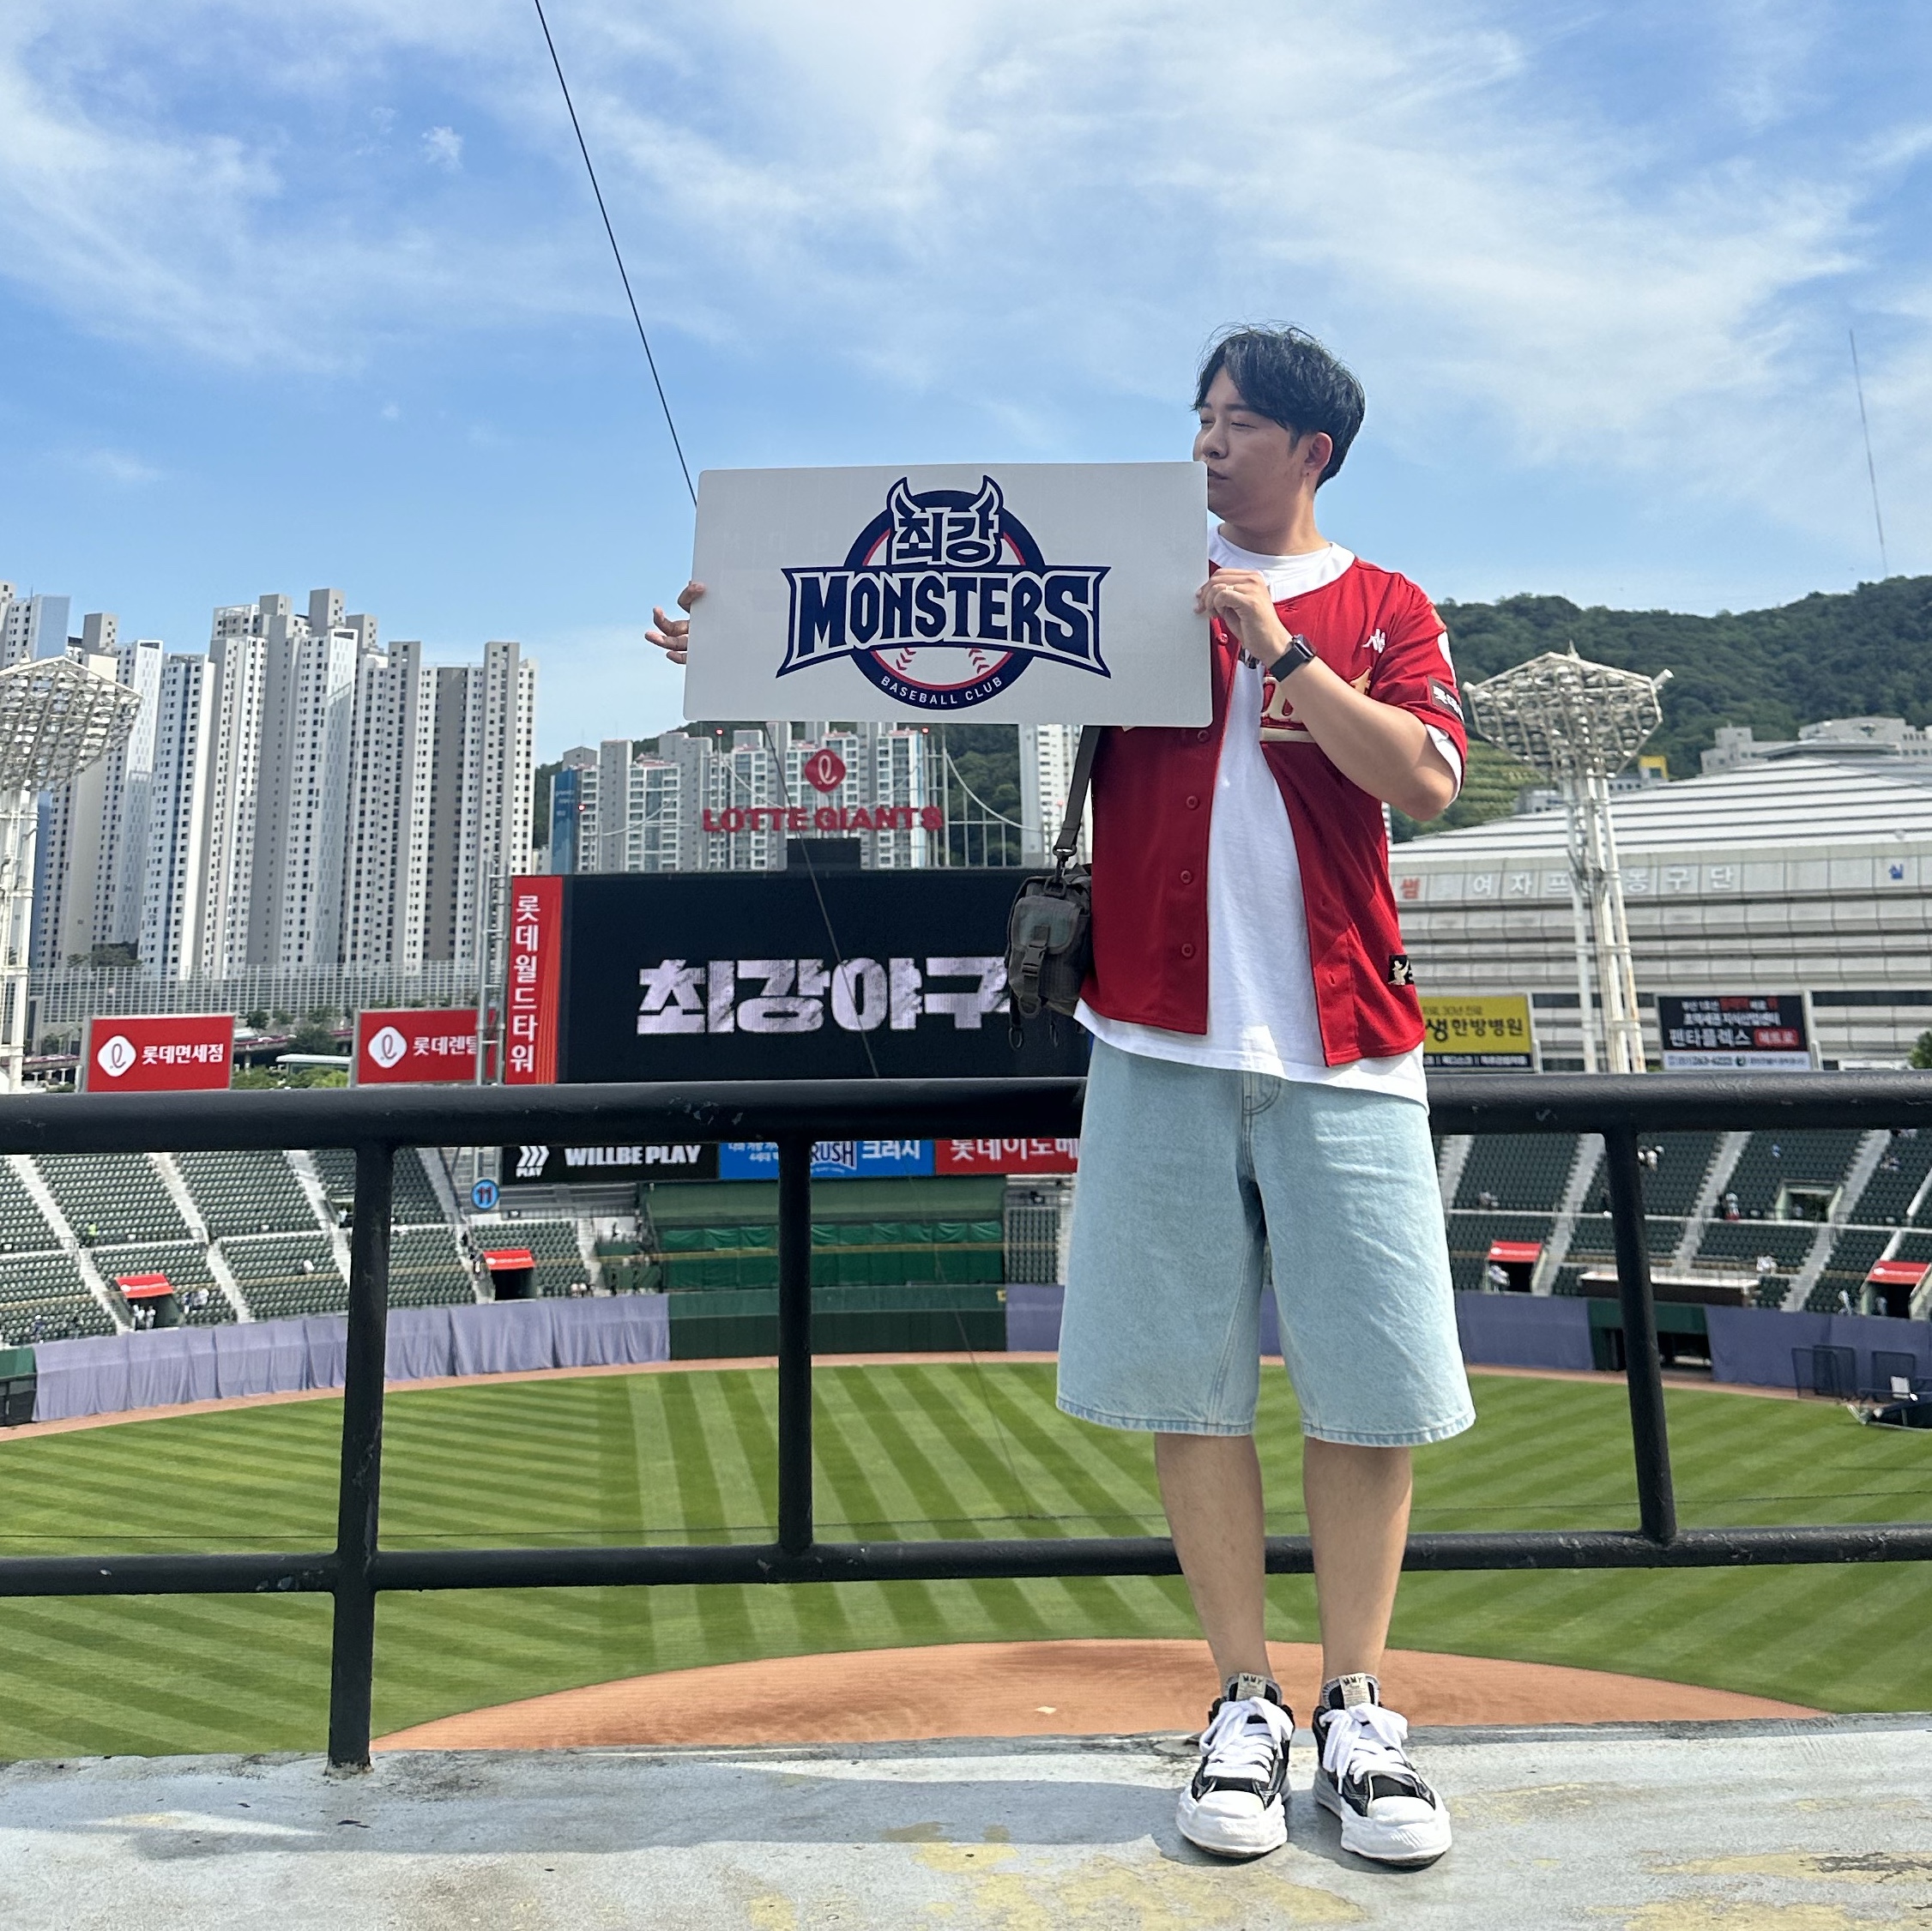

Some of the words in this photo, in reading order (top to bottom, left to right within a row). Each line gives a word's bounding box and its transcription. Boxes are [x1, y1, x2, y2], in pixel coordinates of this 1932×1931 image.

[895, 499, 995, 565] 최강
[796, 575, 1094, 660] MONSTERS
[881, 676, 957, 705] BASEBALL
[965, 677, 1002, 701] CLUB
[703, 806, 808, 832] LOTTE
[815, 805, 943, 831] GIANTS
[510, 895, 540, 1073] 롯데월드타워
[637, 956, 1011, 1035] 최강야구
[1425, 1018, 1523, 1042] 생한방병원
[142, 1043, 224, 1065] 롯데면세점
[565, 1147, 643, 1166] WILLBE
[645, 1145, 702, 1164] PLAY
[811, 1142, 854, 1167] RUSH
[516, 1167, 543, 1178] PLAY
[477, 1186, 493, 1204] 11
